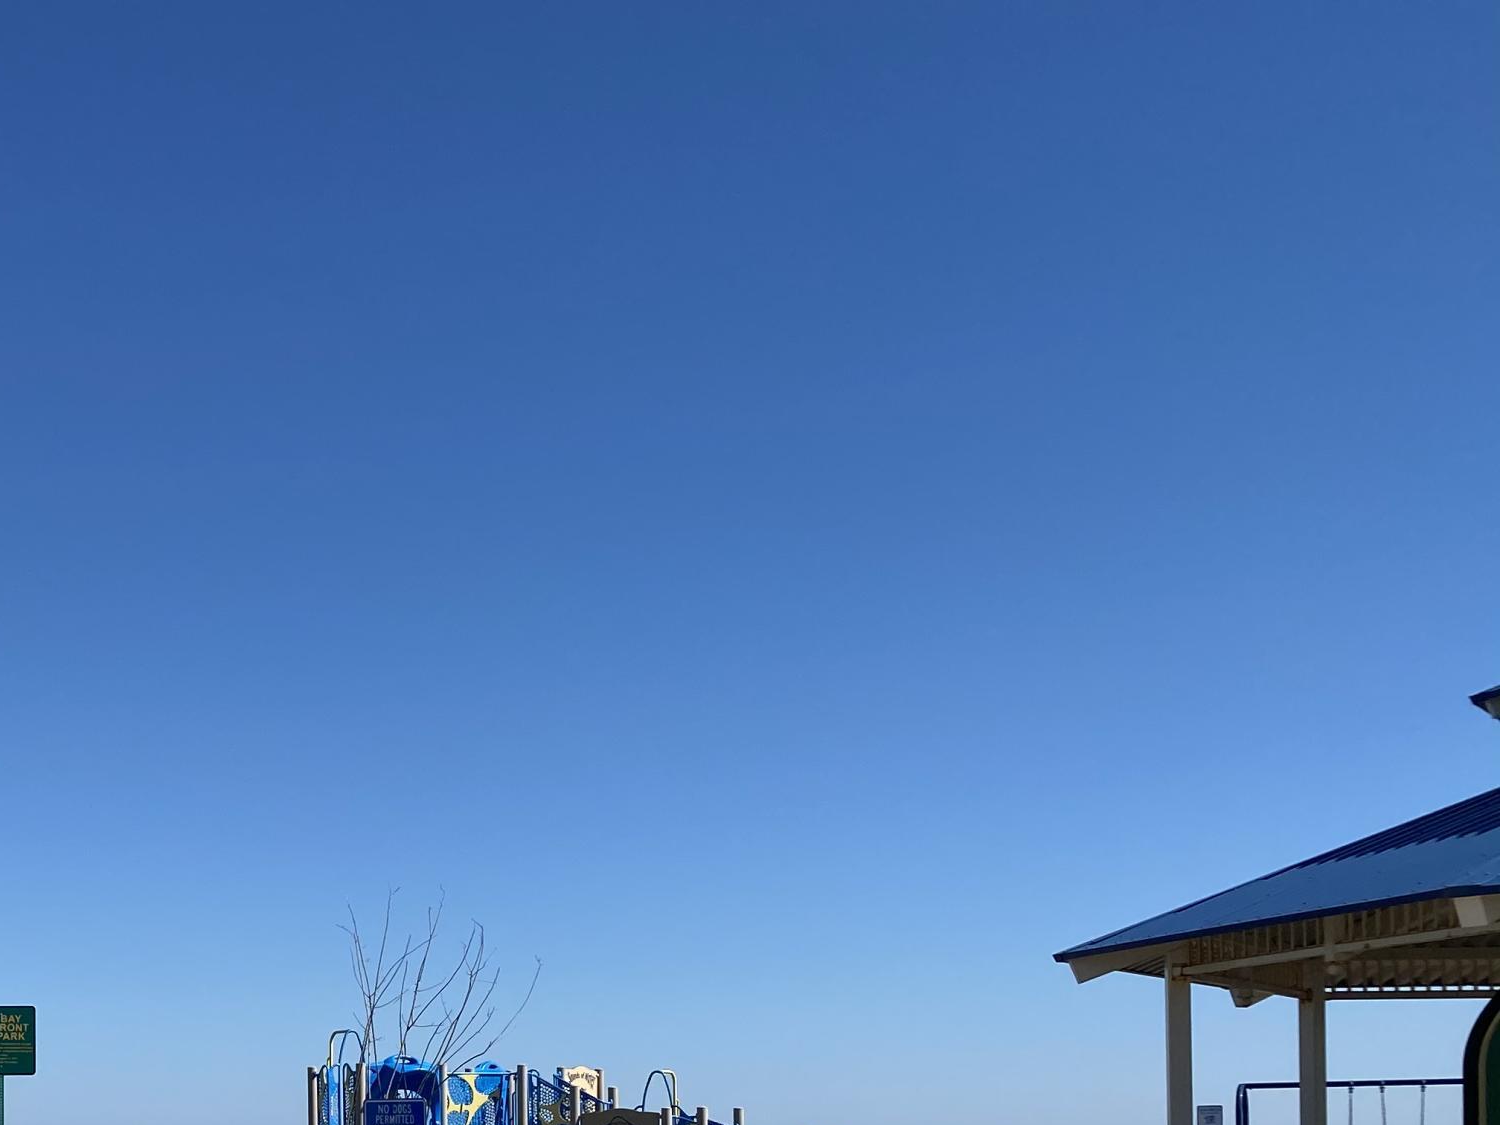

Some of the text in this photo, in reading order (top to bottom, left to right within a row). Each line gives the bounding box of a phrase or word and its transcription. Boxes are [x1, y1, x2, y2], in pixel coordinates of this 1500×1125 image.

[0, 1014, 21, 1023] BAY
[378, 1104, 412, 1114] NO DOGS
[375, 1114, 415, 1125] PERMITTED
